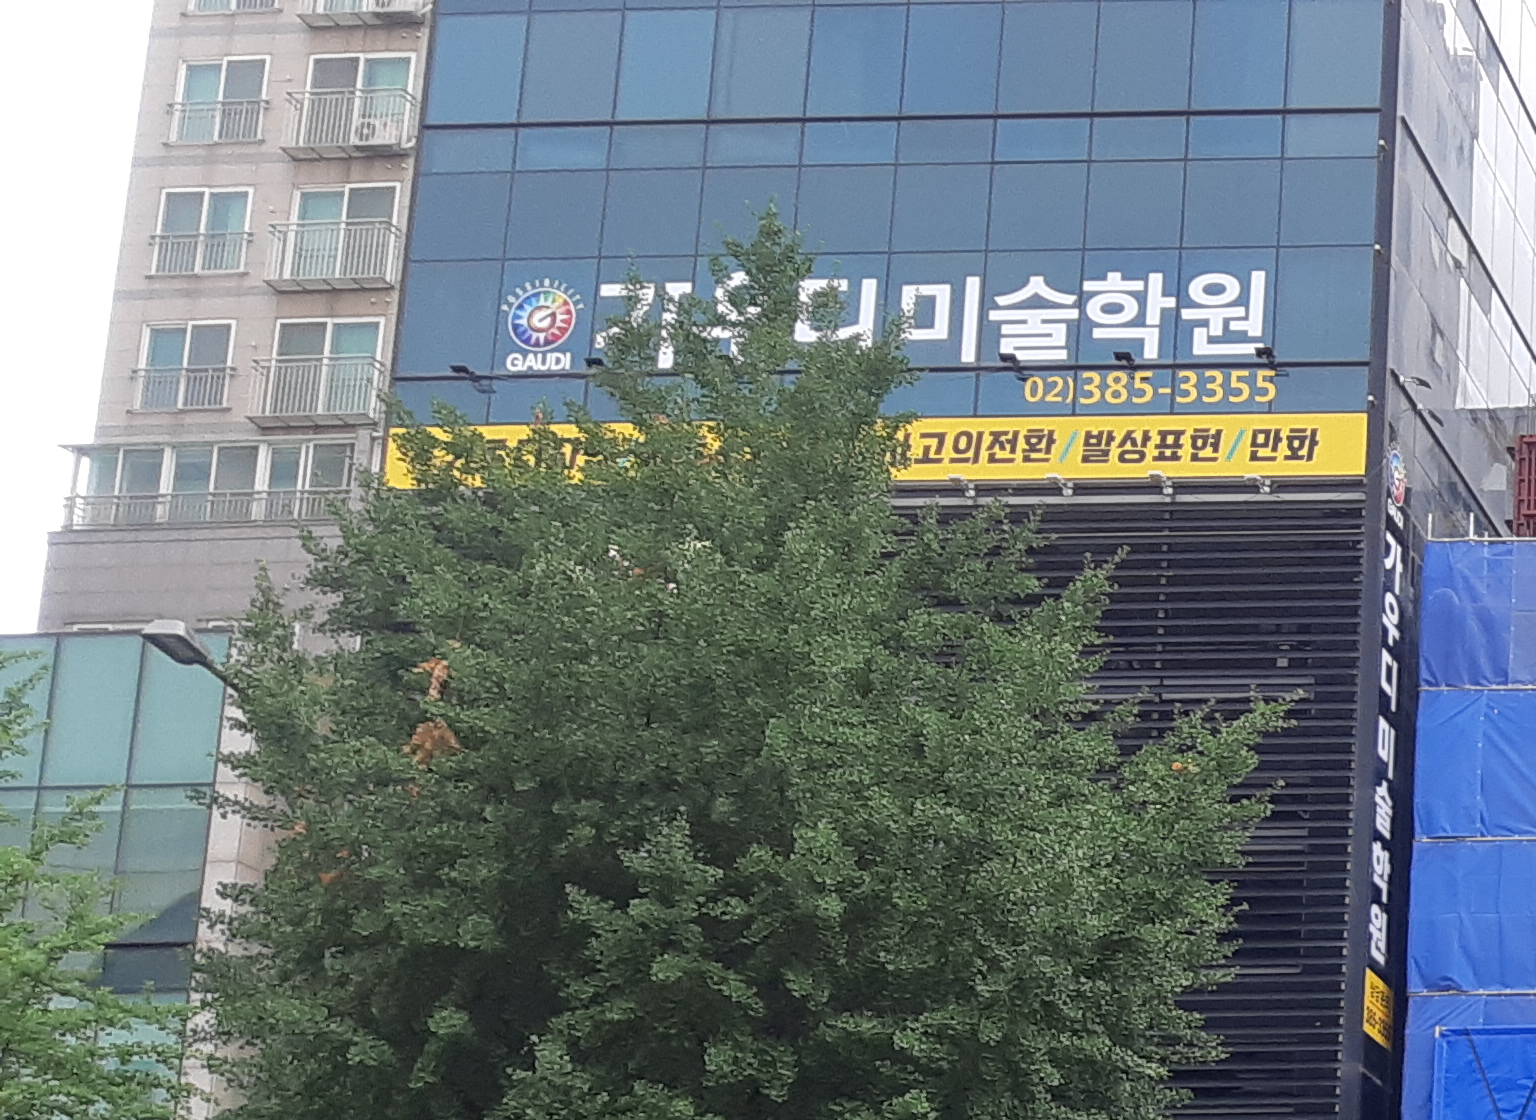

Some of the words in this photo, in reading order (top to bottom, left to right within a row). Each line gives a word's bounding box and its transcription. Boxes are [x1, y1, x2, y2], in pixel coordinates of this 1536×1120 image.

[900, 268, 1268, 364] 미술학원
[506, 352, 572, 372] GAUDI
[1023, 370, 1278, 405] 02)385-3355
